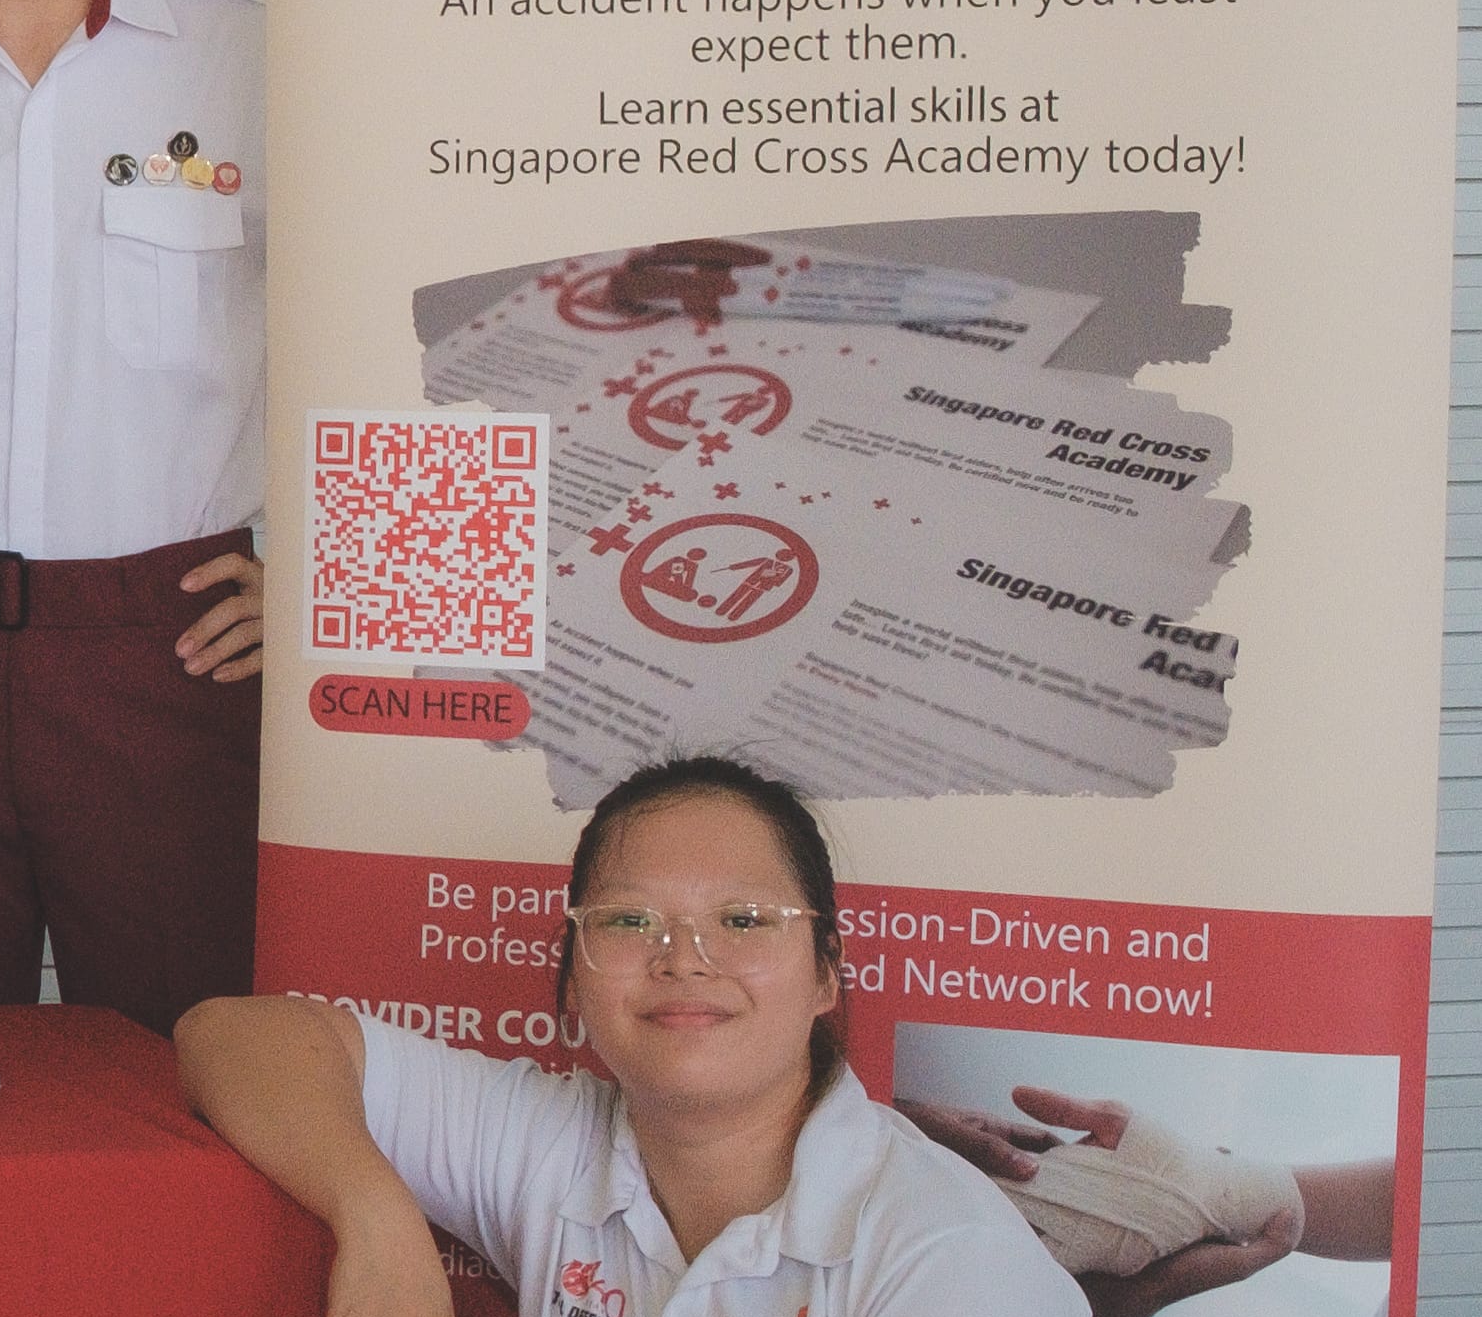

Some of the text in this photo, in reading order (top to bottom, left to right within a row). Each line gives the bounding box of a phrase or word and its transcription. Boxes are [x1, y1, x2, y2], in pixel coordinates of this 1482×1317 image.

[690, 24, 968, 73] expect them.
[599, 86, 1060, 127] Learn essential skills at
[428, 134, 1246, 185] Singapore Red Cross Academy today!
[903, 384, 1212, 466] Singapore Red Cross
[1046, 443, 1198, 492] Academy
[956, 557, 1134, 628] Singapore
[1140, 612, 1222, 654] Red
[320, 683, 514, 725] SCAN HERE
[427, 873, 1211, 962] Be part ssion-Driven and
[420, 924, 1213, 1019] Profess ed Network now!
[496, 1010, 587, 1050] COU
